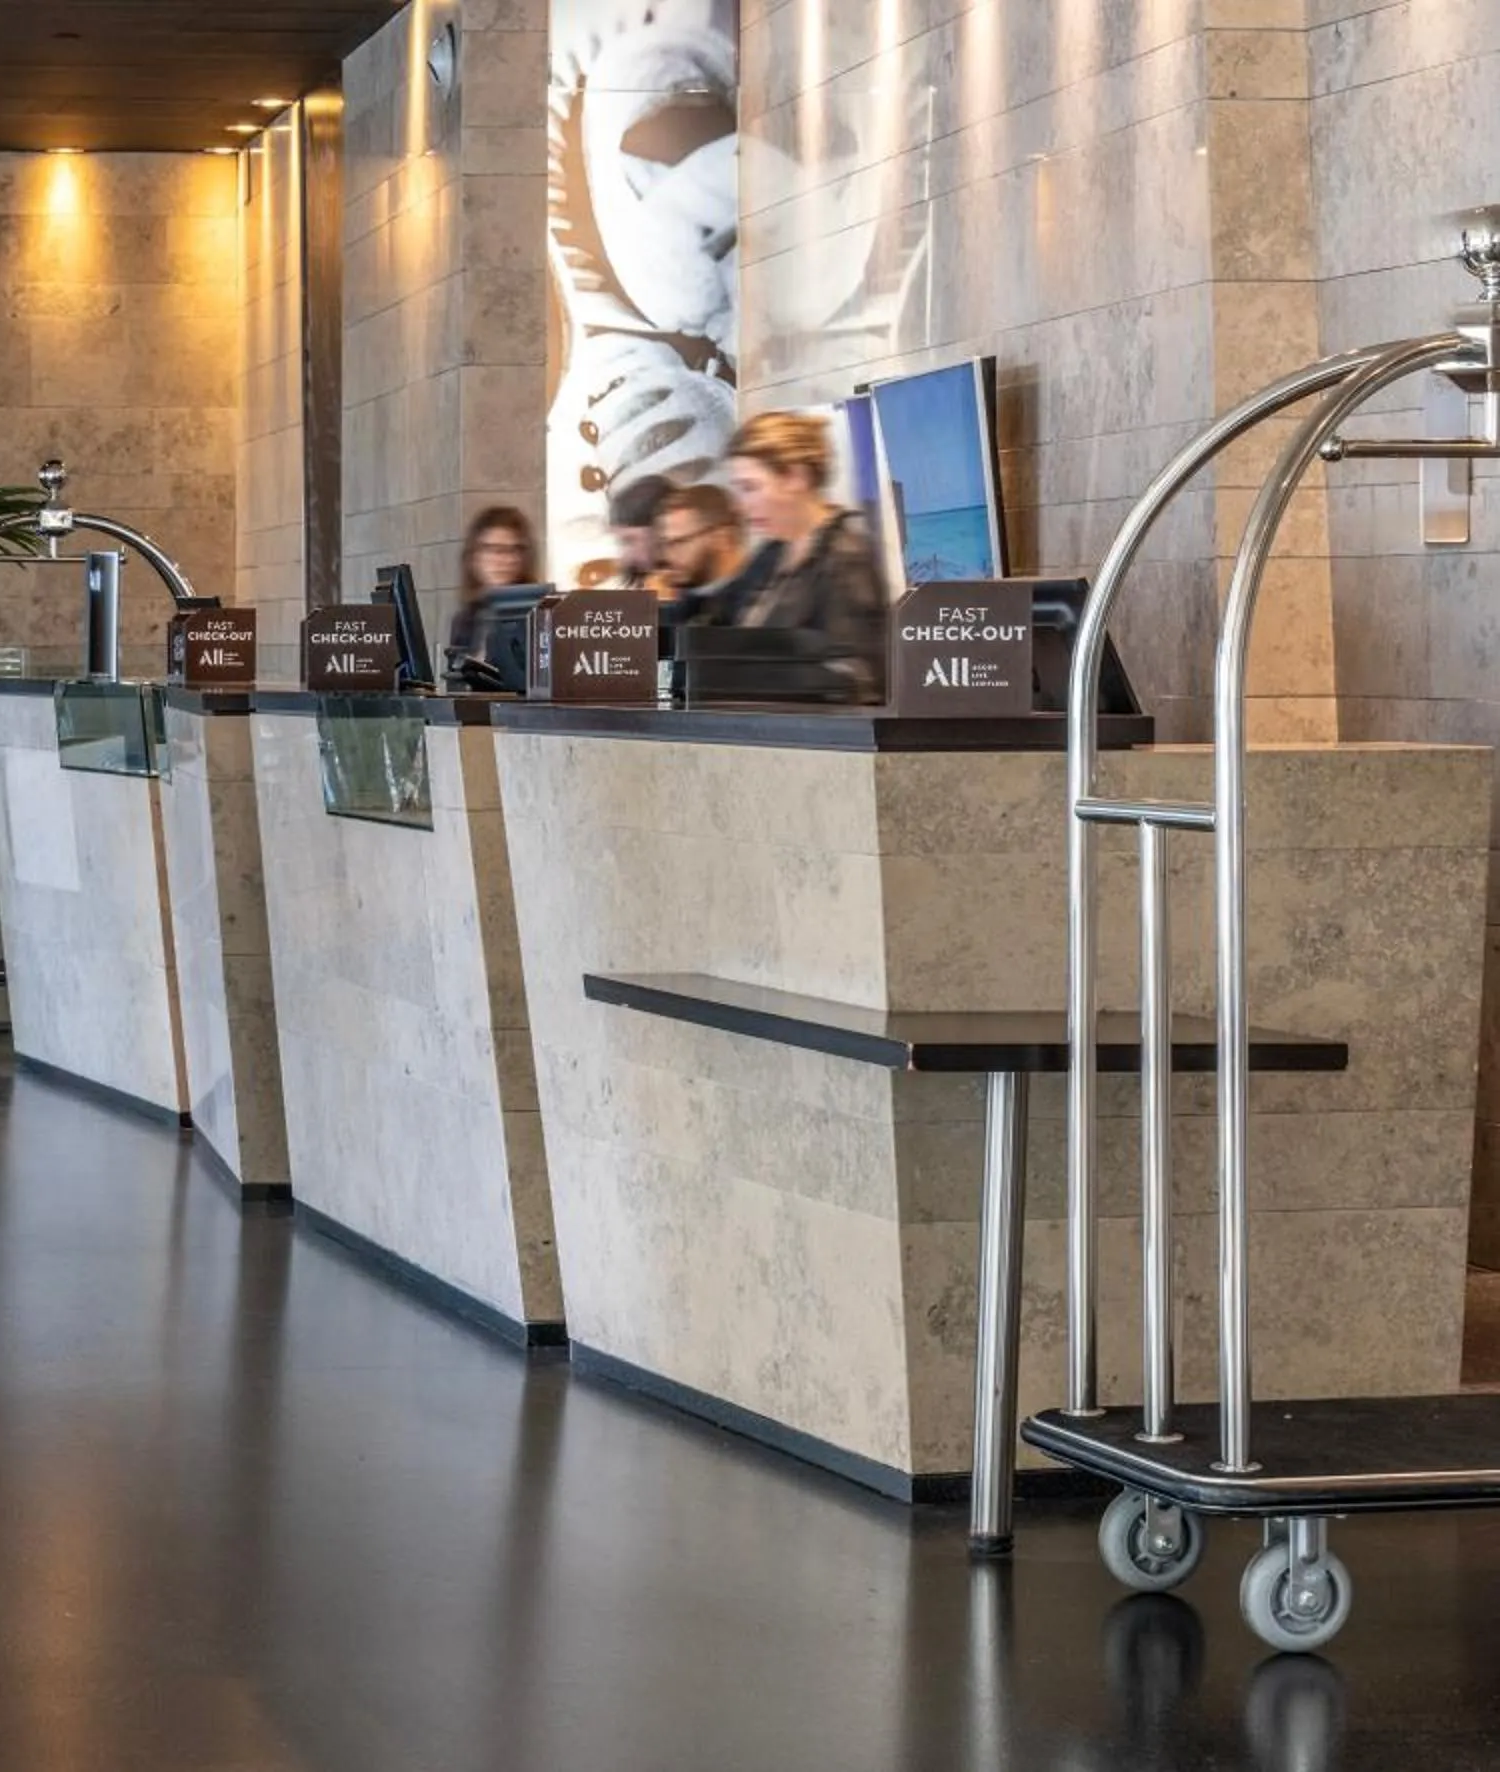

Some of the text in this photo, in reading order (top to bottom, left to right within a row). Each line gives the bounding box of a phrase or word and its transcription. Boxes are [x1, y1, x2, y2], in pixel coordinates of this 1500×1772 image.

[584, 611, 623, 623] FAST
[938, 607, 988, 622] FAST
[207, 621, 235, 630] FAST
[335, 621, 367, 631] FAST
[187, 631, 253, 641] CHECK-OUT
[555, 626, 653, 639] CHECK-OUT
[901, 625, 1027, 641] CHECK-OUT
[311, 633, 392, 644] CHECK-OUT
